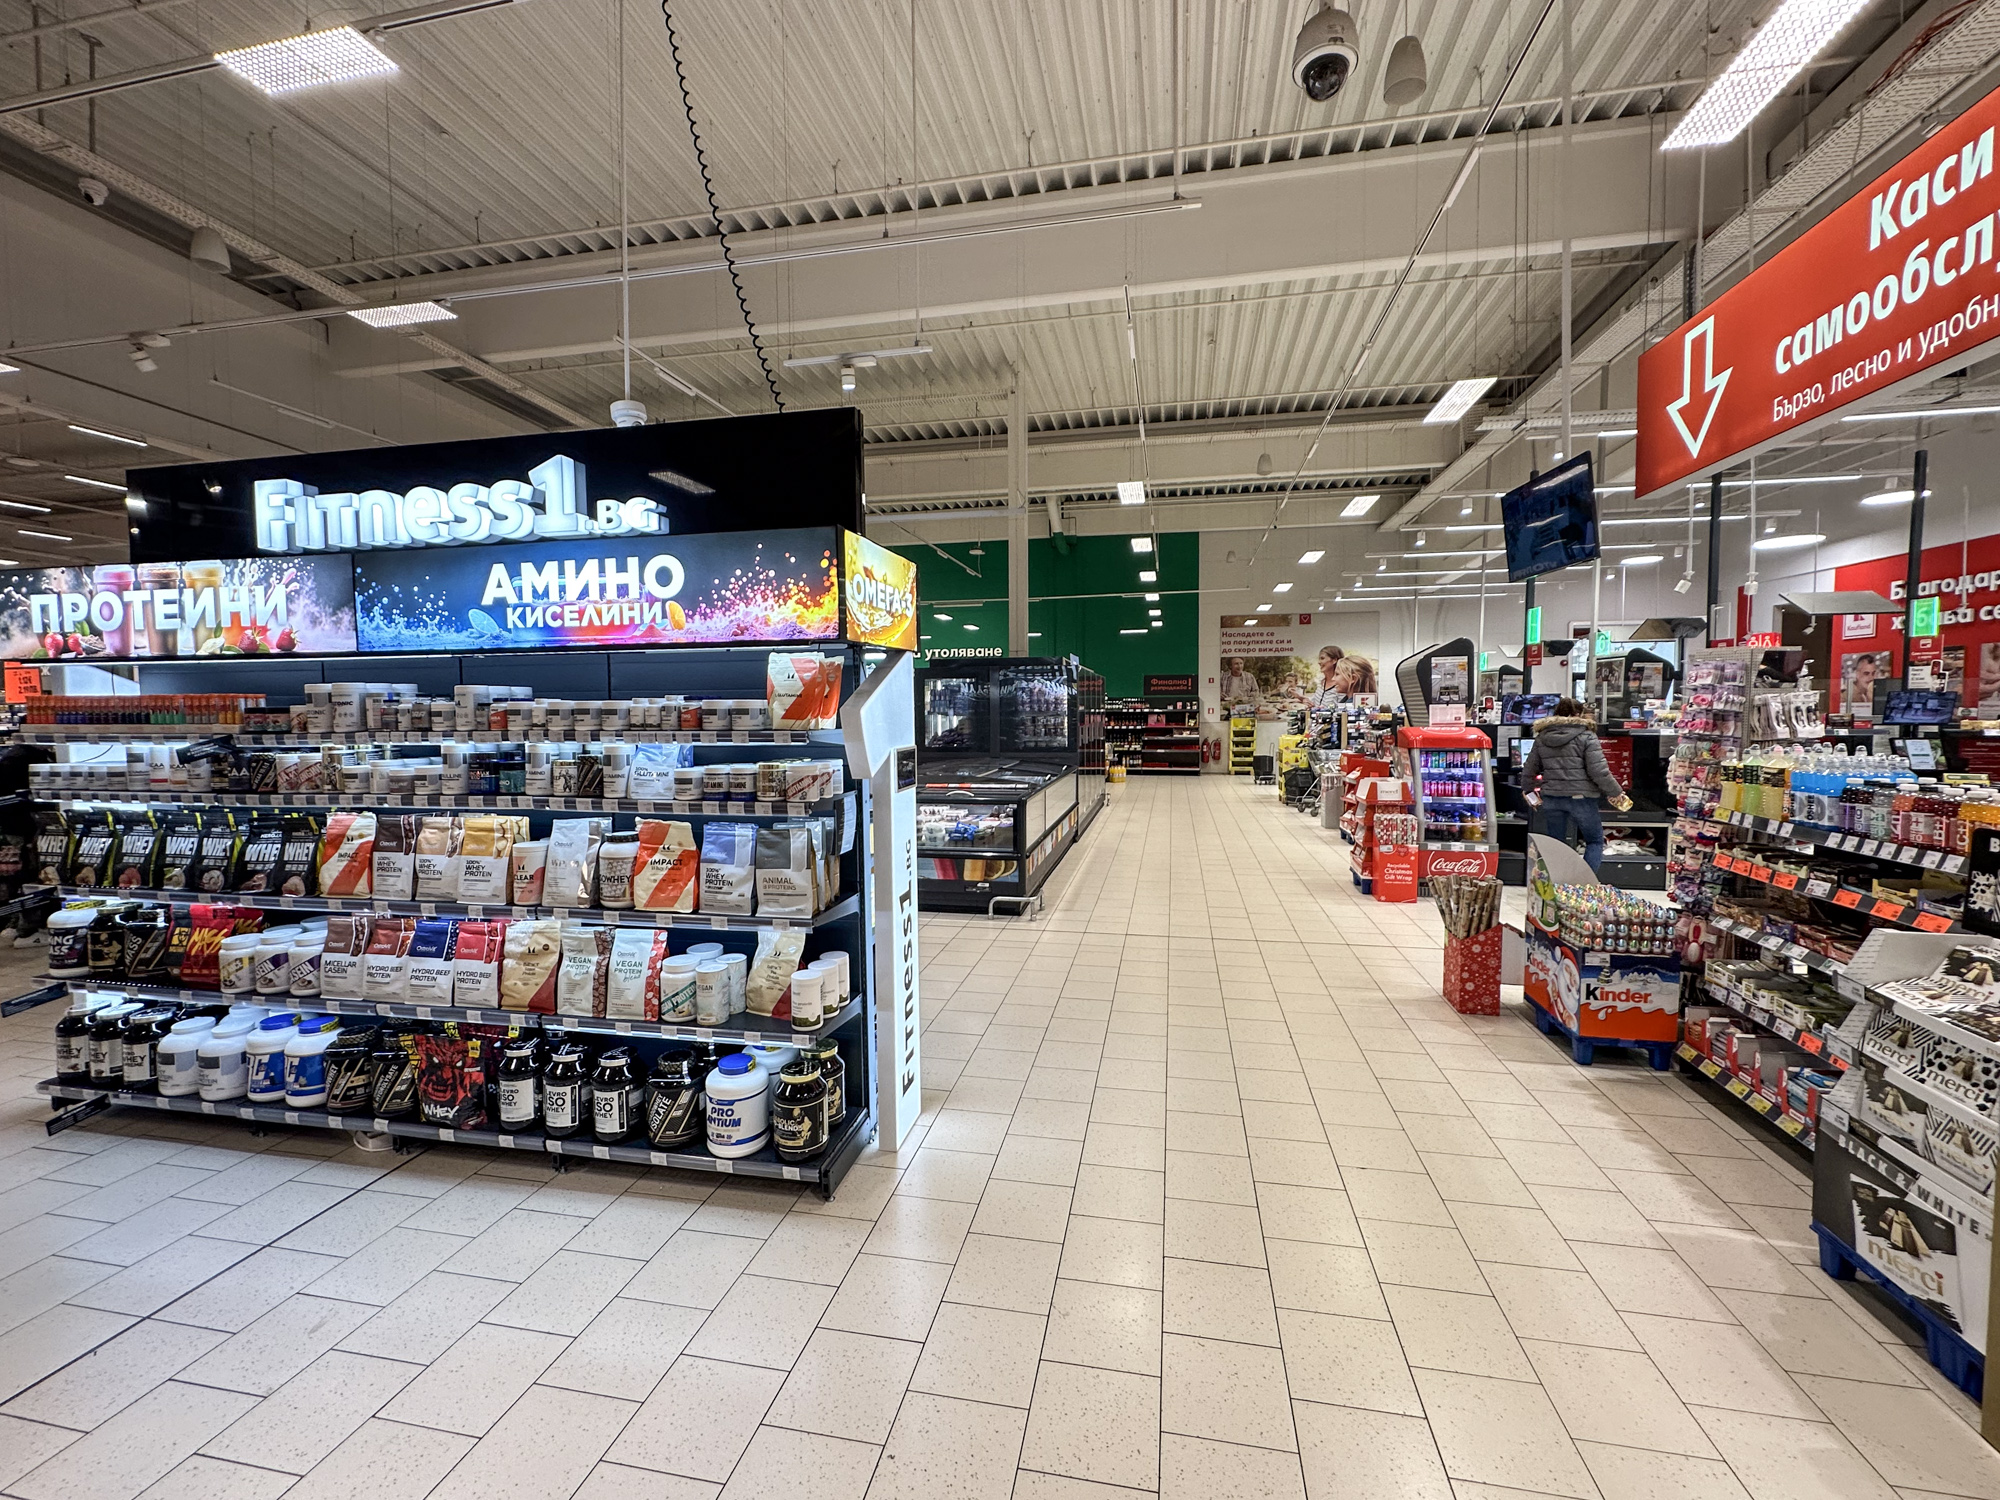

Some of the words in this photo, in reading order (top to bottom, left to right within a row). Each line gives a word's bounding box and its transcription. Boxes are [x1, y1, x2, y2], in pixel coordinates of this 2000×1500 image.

[1869, 126, 1995, 250] Каси
[1774, 208, 2000, 374] самообсл
[1772, 384, 1827, 422] Бързо,
[1830, 348, 1891, 395] лесно
[1897, 337, 1911, 364] и
[1917, 292, 2000, 362] удобн
[481, 554, 686, 606] АМИНО
[1890, 570, 2000, 600] Багодар
[852, 573, 913, 617] ОМЕГА-3
[30, 585, 288, 633] ПРОТЕИНИ
[506, 601, 664, 629] КИСЕЛИНИ
[1222, 631, 1265, 640] Насладете
[1234, 638, 1274, 647] покупките
[925, 647, 1003, 661] утоляване
[1234, 647, 1256, 655] скоро
[1806, 794, 1815, 820] OSHEE
[78, 837, 113, 854] WHEY
[122, 836, 156, 853] WHEY
[283, 843, 316, 861] WHEY
[704, 879, 734, 887] PROTEIN
[762, 877, 794, 885] ANIMAL
[324, 960, 357, 968] MICELLAR
[1885, 984, 1942, 1010] merci
[1938, 976, 1995, 1002] merci
[1866, 1036, 1916, 1068] merci
[1926, 1067, 1985, 1102] merci
[650, 1095, 672, 1132] ISOLATE
[710, 1106, 734, 1118] PRO
[1838, 1134, 1888, 1175] BLACK
[1896, 1174, 1908, 1188] &
[1917, 1184, 1980, 1236] WHITE
[1868, 1239, 1944, 1297] merci
